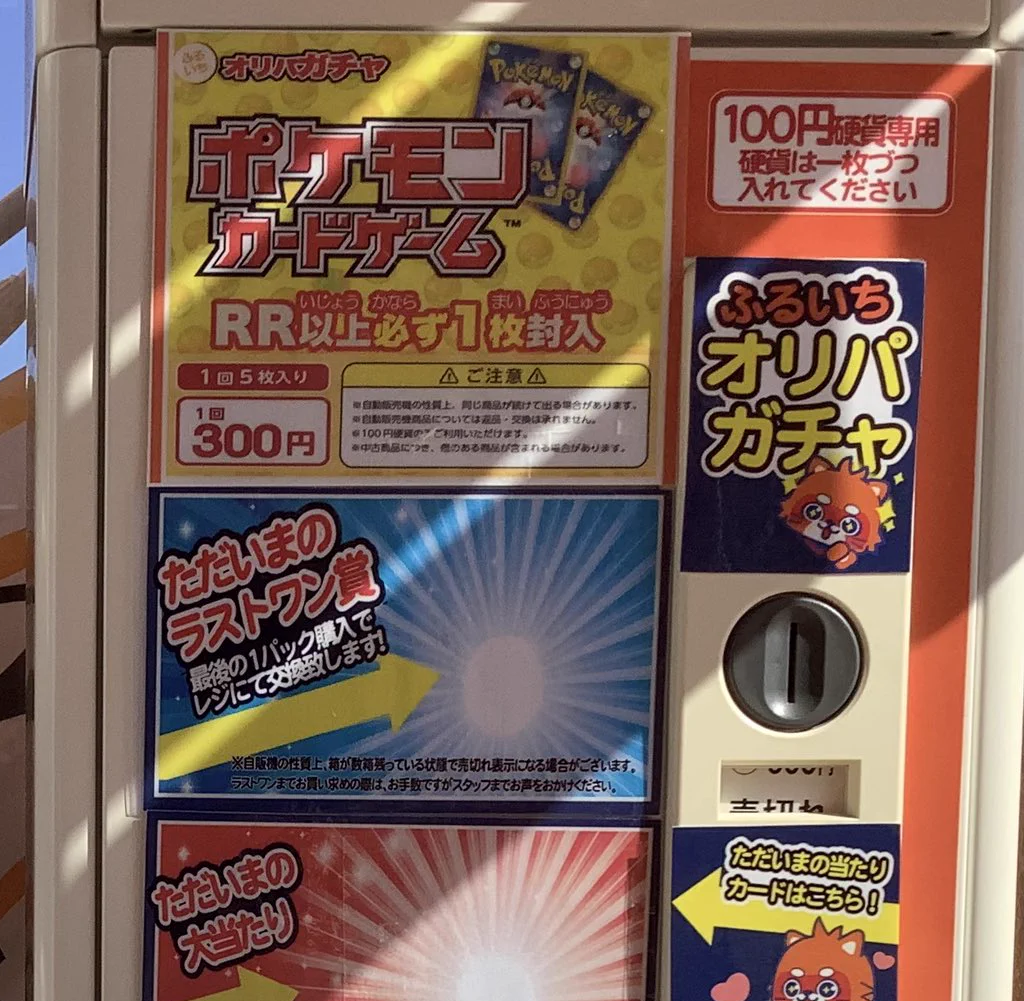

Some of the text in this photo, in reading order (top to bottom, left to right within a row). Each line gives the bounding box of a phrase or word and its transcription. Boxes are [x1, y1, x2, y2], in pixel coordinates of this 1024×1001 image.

[724, 102, 941, 148] 100円硬貨専用
[191, 118, 530, 203] ポケモン
[738, 149, 920, 176] 硬貨は一枚づつ
[737, 177, 918, 203] 入れてください
[204, 208, 504, 274] カードゲーム
[299, 292, 360, 310] いじょう
[369, 294, 417, 310] かなら
[720, 278, 891, 324] ふるいち
[467, 367, 524, 385] ご注意
[705, 332, 911, 399] オリパ
[196, 407, 225, 420] 1回
[192, 423, 315, 458] 300円
[709, 401, 906, 476] ガチャ
[162, 513, 333, 605] ただいまの
[171, 551, 376, 658] ラストワン賞
[190, 608, 373, 692] 最後の1パック購入で
[731, 844, 888, 881] ただいまの当たり
[155, 852, 295, 922] ただいまの
[181, 901, 291, 969] 大当たり
